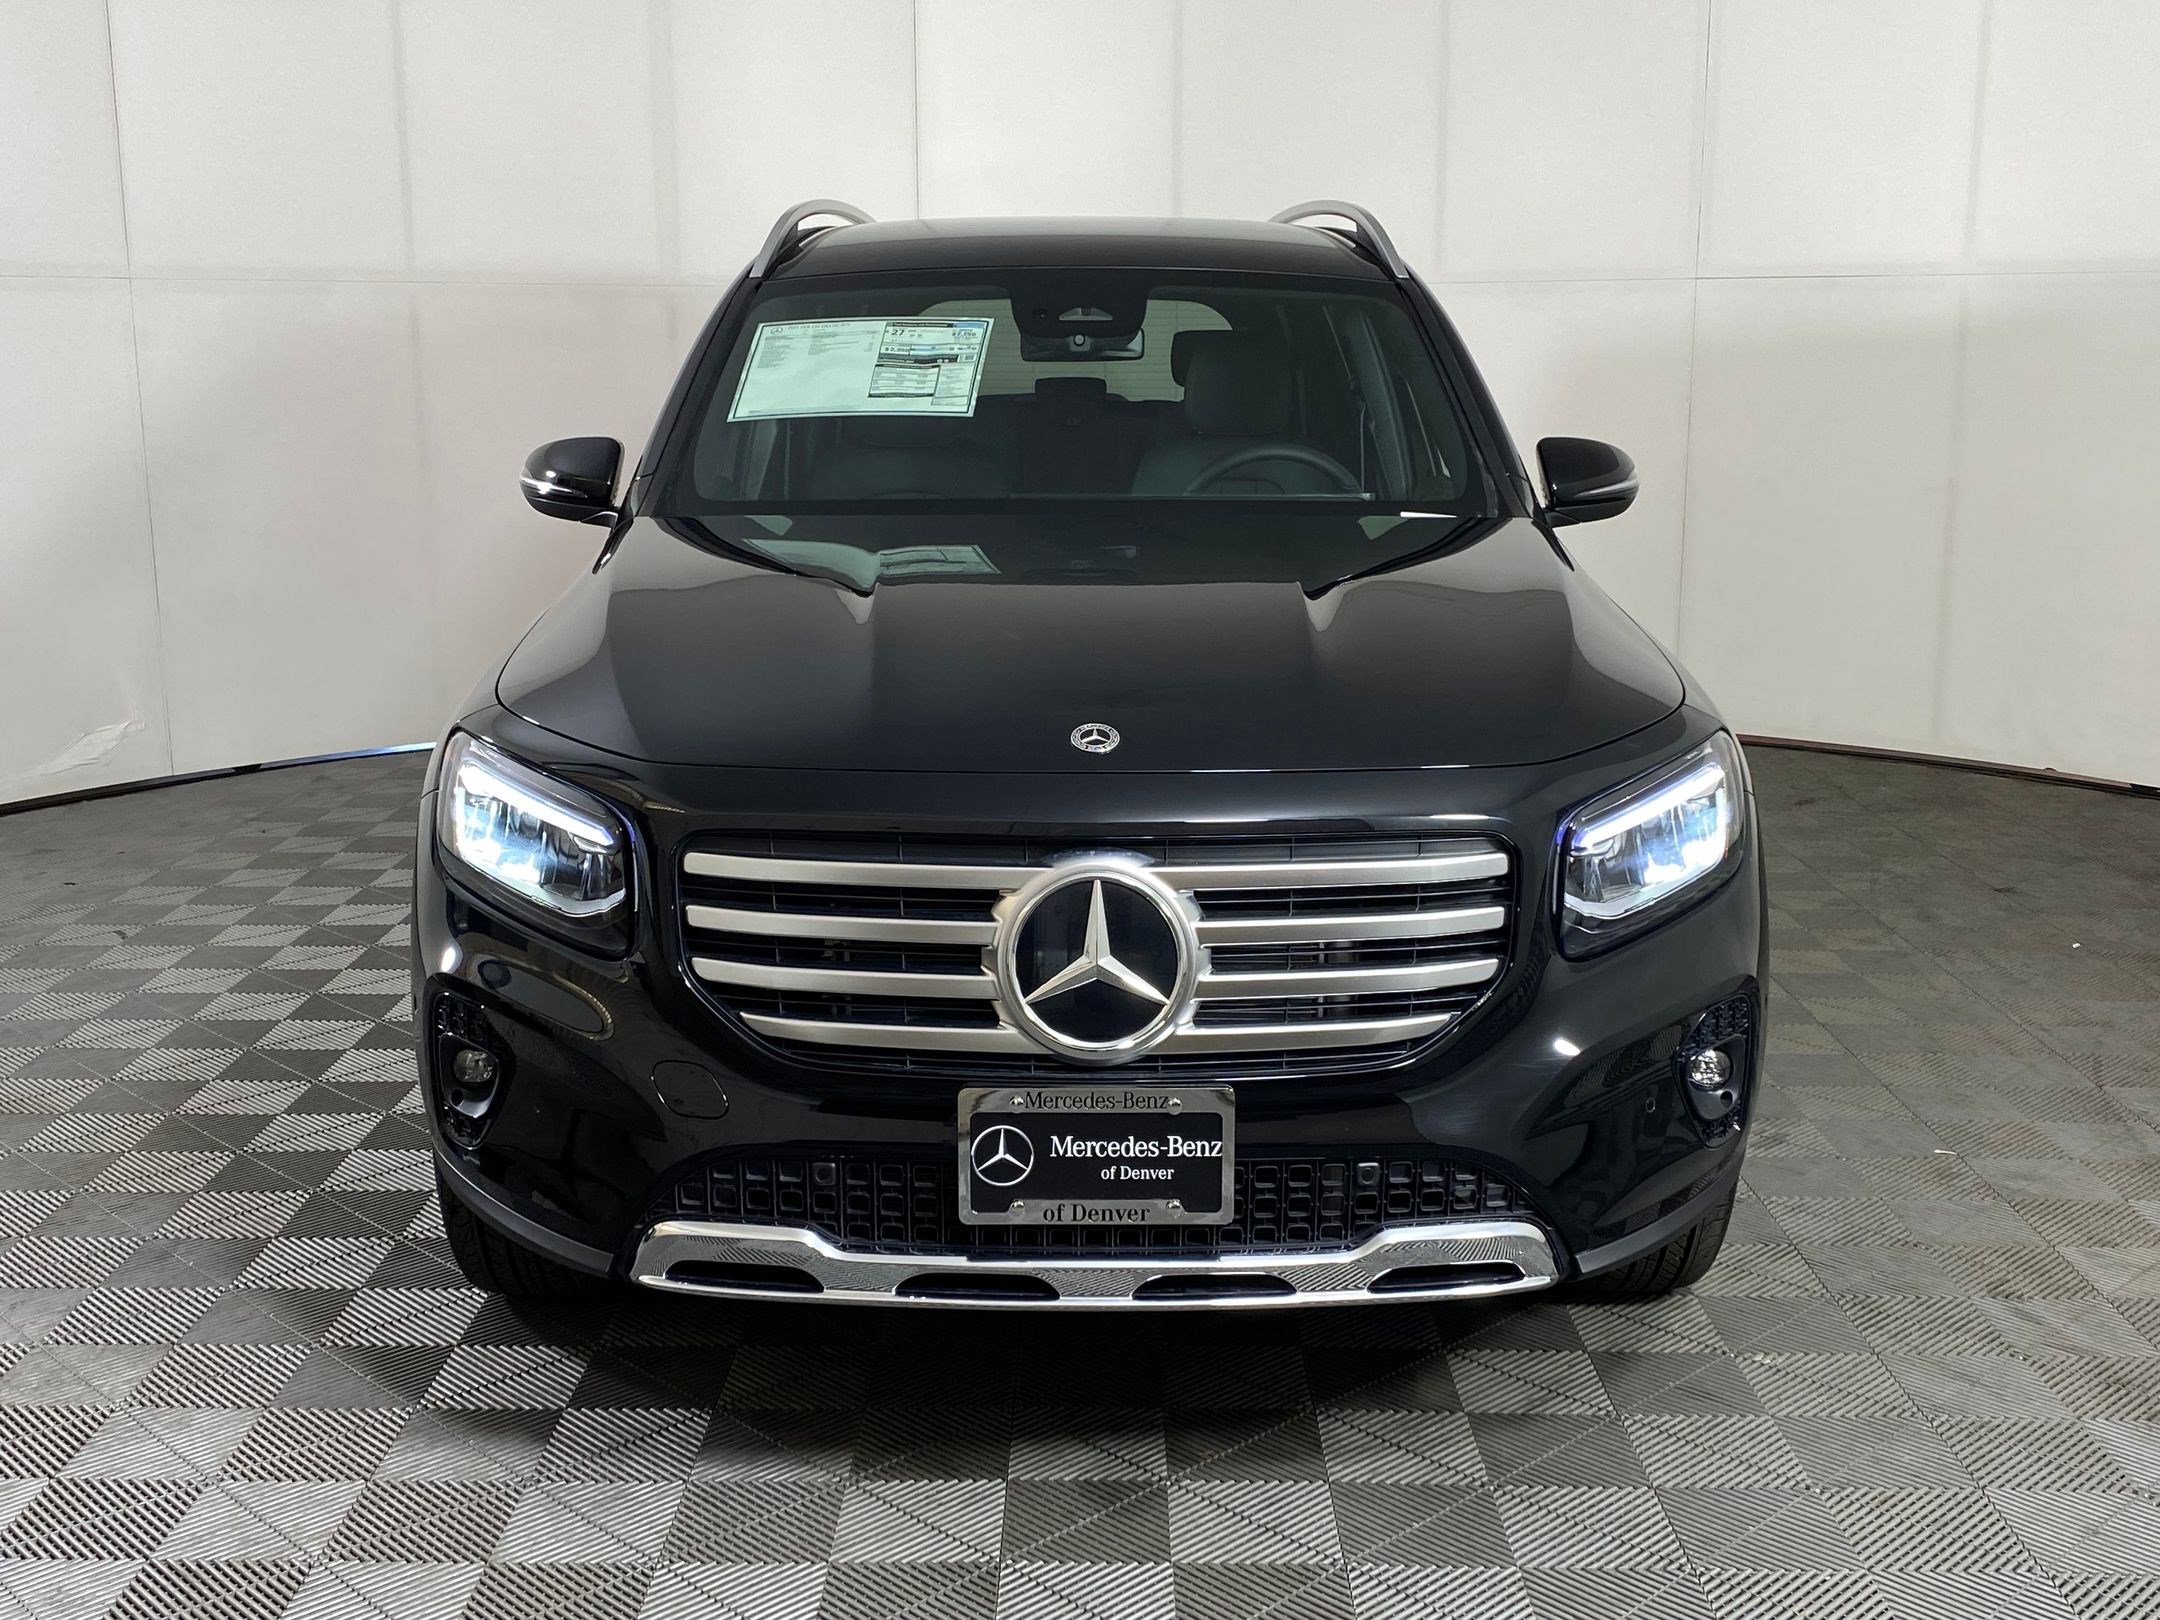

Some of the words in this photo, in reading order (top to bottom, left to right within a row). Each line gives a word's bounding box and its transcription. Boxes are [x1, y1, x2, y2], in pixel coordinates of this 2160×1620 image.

[1025, 1091, 1170, 1110] Mercedes-Benz
[1050, 1135, 1223, 1158] Mercedes-Benz
[1101, 1166, 1117, 1180] of
[1120, 1166, 1175, 1180] Denver
[1043, 1204, 1064, 1222] of
[1070, 1204, 1150, 1223] Denver
